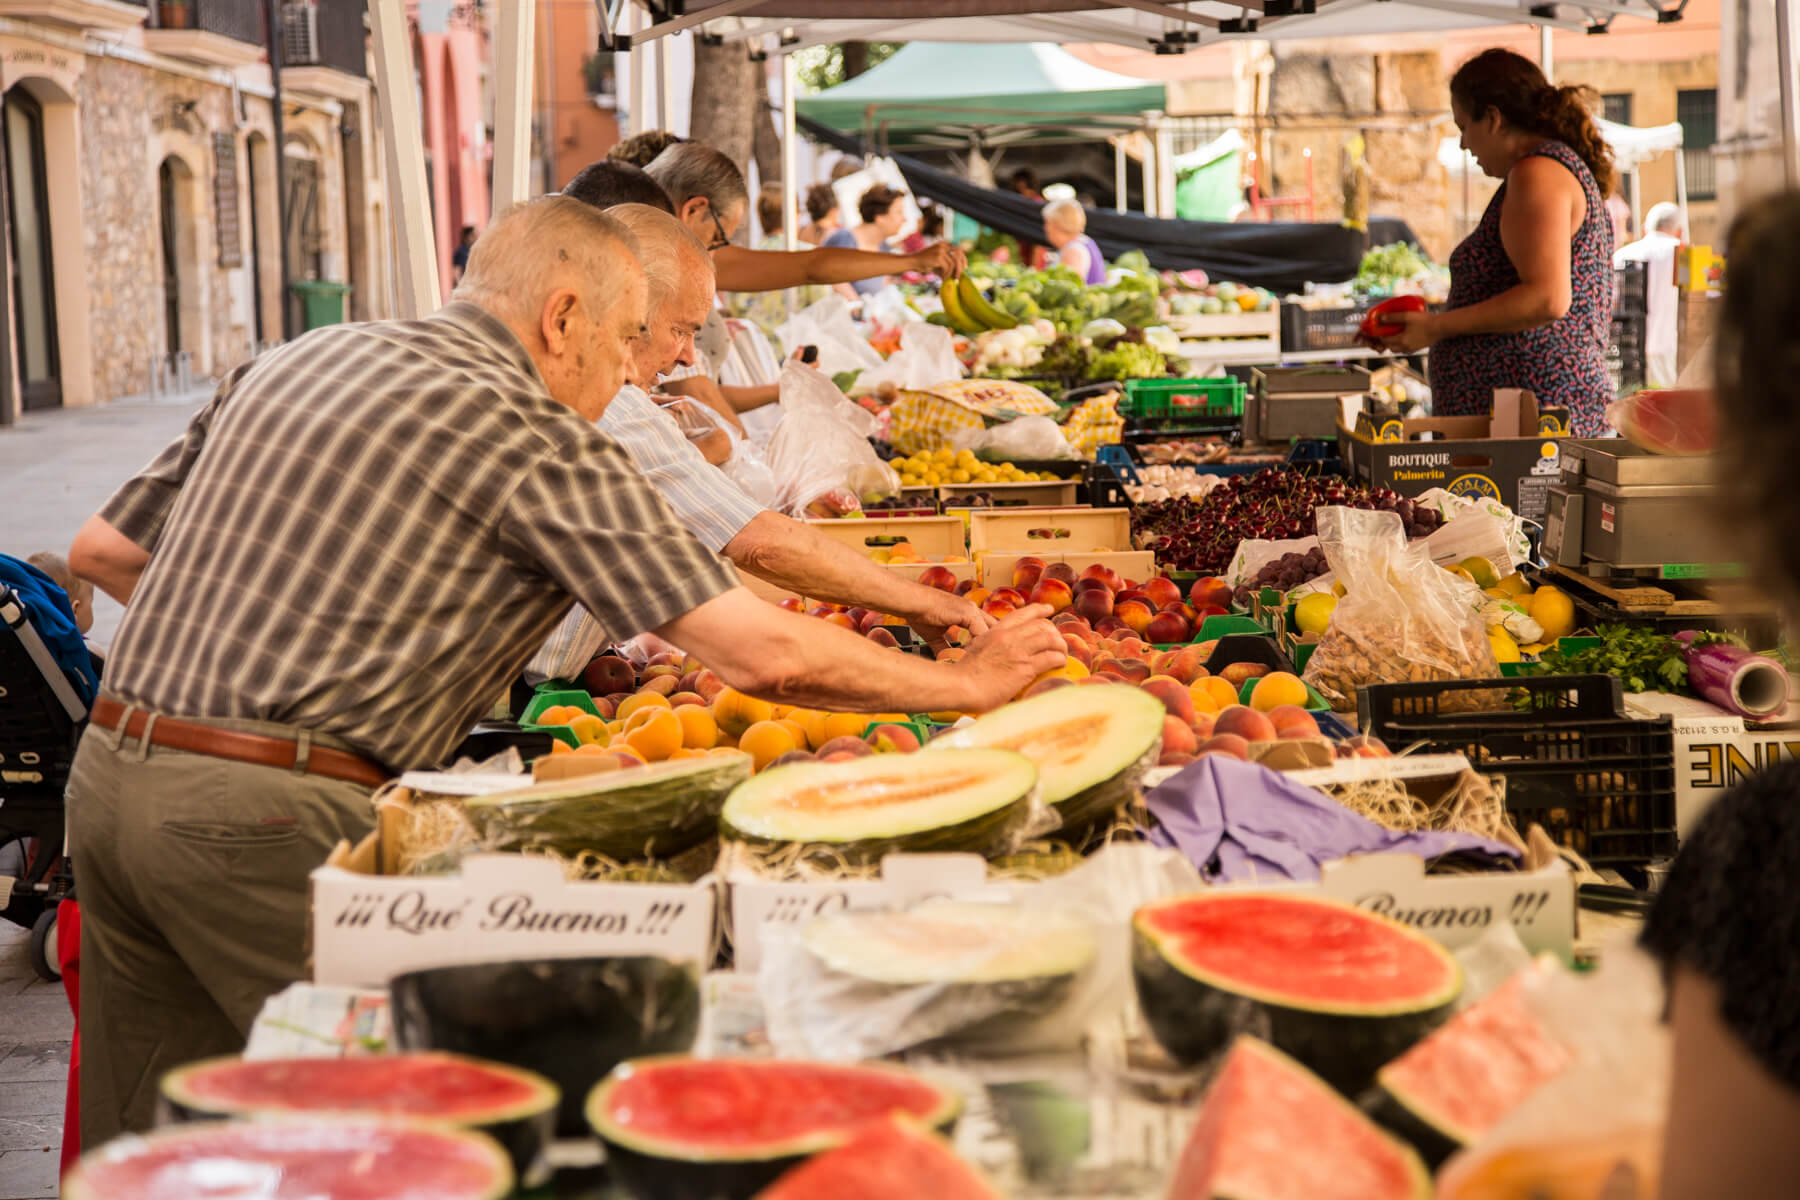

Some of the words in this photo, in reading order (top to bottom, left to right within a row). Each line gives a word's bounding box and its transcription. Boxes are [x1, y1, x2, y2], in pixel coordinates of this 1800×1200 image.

[1388, 452, 1451, 468] BOUTIQUE
[1393, 469, 1446, 481] Palmerita
[1688, 742, 1800, 789] INE
[479, 893, 629, 935] Buenos
[634, 900, 686, 936] !!!
